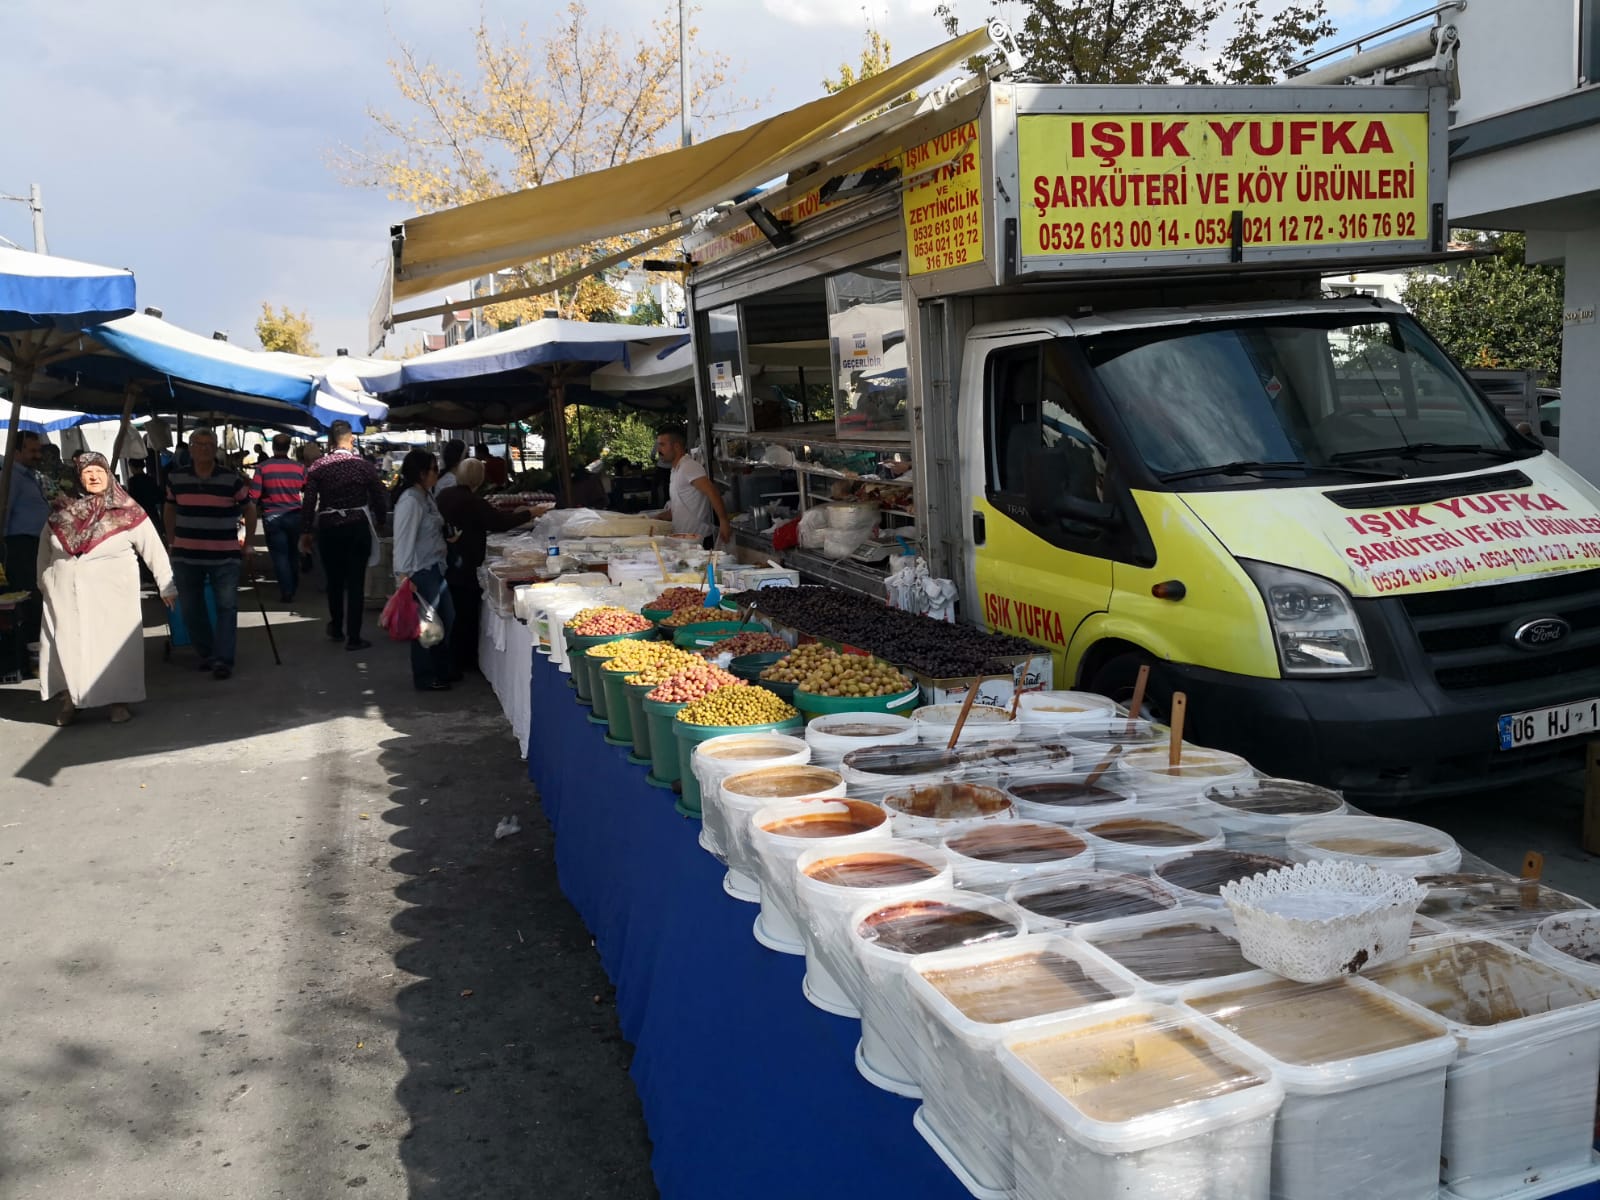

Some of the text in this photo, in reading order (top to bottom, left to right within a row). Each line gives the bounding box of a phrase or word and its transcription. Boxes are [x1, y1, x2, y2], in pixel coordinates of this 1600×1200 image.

[906, 122, 977, 170] IŞIK YUFKA
[1071, 121, 1393, 167] IŞIK YUFKA
[909, 187, 979, 226] ZEYTİNCİLİK
[936, 185, 949, 197] VE
[1034, 161, 1415, 217] ŞARKÜTERİ VE KÖY ÜRÜNLERİ
[913, 210, 978, 242] 0532 613 00 14
[914, 228, 979, 257] 0534 021 12 72
[1039, 222, 1085, 251] 0532
[1090, 221, 1124, 249] 613
[1130, 220, 1152, 247] 00
[1158, 219, 1179, 246] 14
[1243, 216, 1271, 243] 021
[1279, 215, 1298, 242] 12
[1303, 215, 1323, 241] 72
[1338, 213, 1367, 239] 316
[1372, 212, 1391, 237] 76
[1396, 211, 1415, 237] 92
[926, 248, 967, 270] 316 76 92
[1345, 493, 1568, 537] IŞIK YUFKA
[1345, 527, 1464, 571] ŞARKÜTERİ
[1456, 524, 1495, 543] VE
[1486, 517, 1532, 540] KÖY
[1371, 568, 1410, 592] 0532
[1480, 549, 1514, 569] 0534
[1512, 546, 1540, 564] 021
[1538, 544, 1559, 561] 12
[985, 592, 1066, 647] IŞIK YUFKA
[1530, 623, 1560, 642] Ford
[1502, 735, 1511, 743] TR
[1513, 715, 1535, 743] 06
[1547, 708, 1570, 737] HJ
